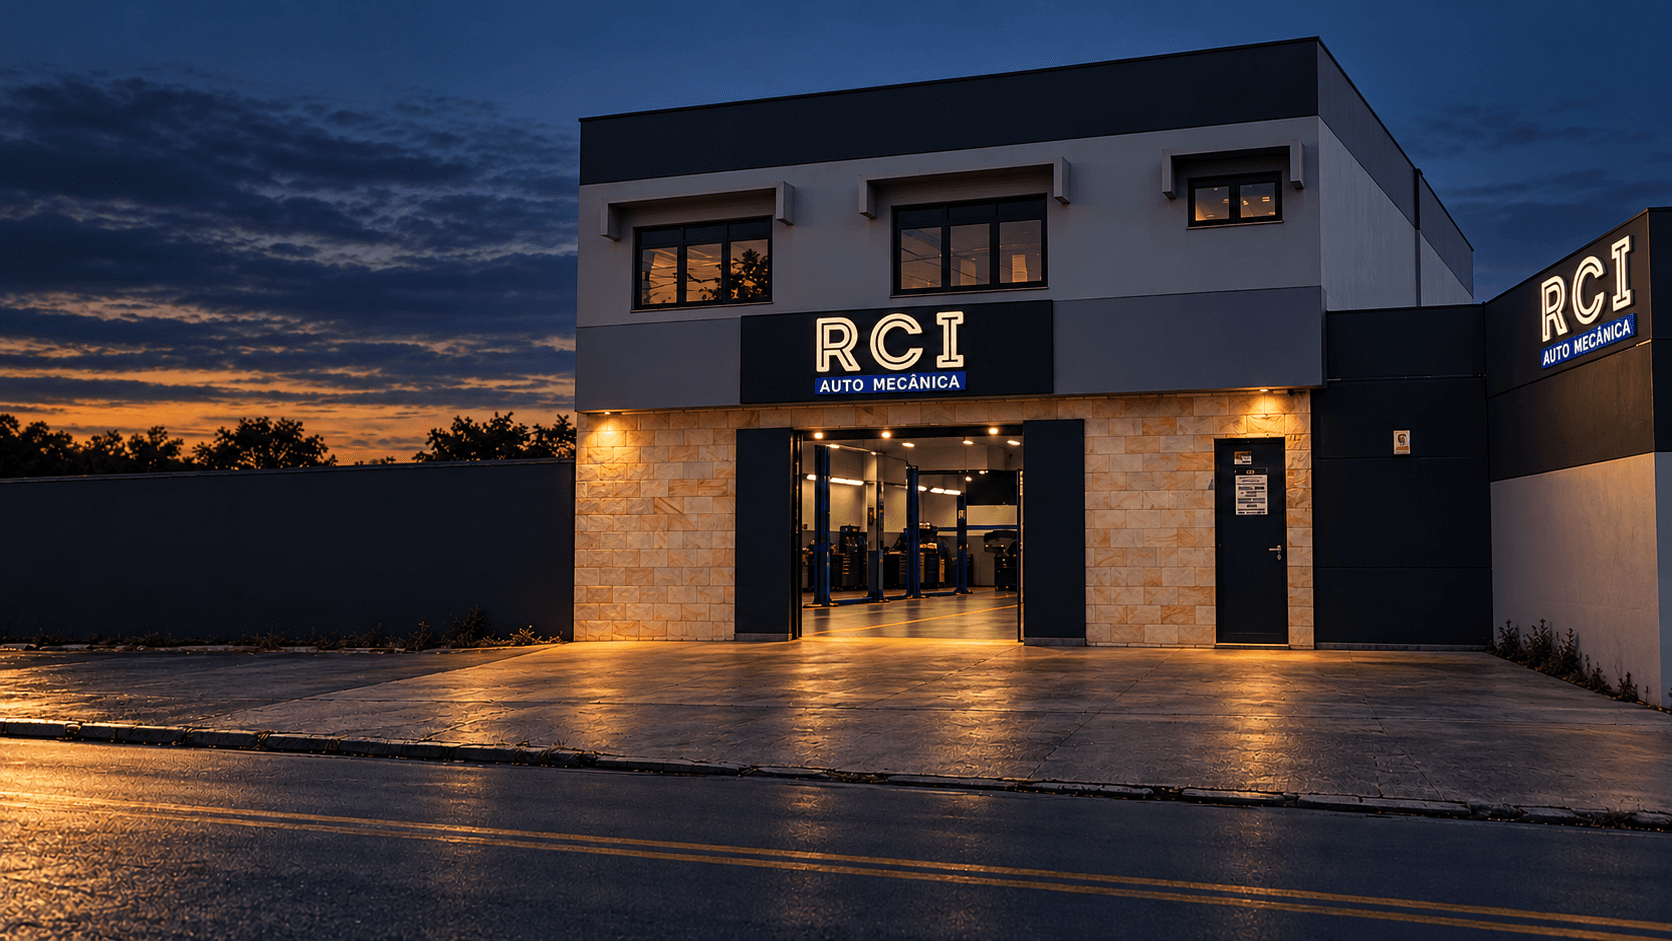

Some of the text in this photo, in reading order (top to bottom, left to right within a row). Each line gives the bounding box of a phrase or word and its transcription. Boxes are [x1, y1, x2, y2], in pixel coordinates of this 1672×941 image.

[1541, 235, 1631, 343] RCI
[815, 311, 964, 373] RCI
[1542, 319, 1631, 366] AUTO MECÂNICA
[819, 373, 960, 393] AUTO MECÂNICA
